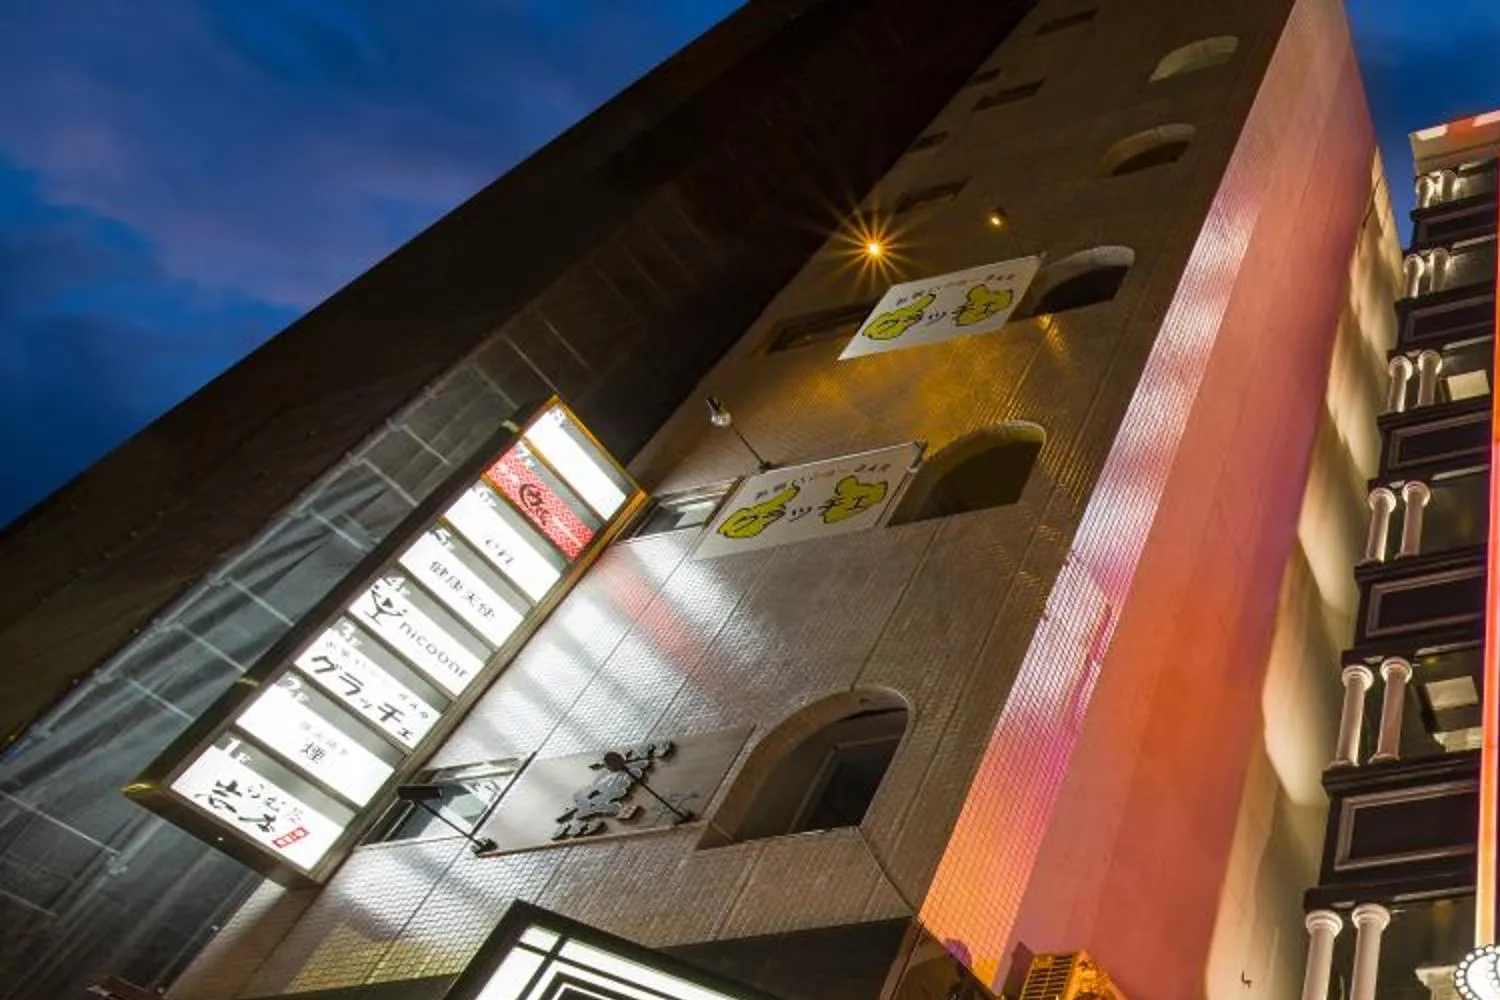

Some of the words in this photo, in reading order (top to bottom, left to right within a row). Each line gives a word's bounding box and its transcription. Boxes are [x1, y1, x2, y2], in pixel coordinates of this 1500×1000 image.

[310, 655, 415, 741] グラッチェ
